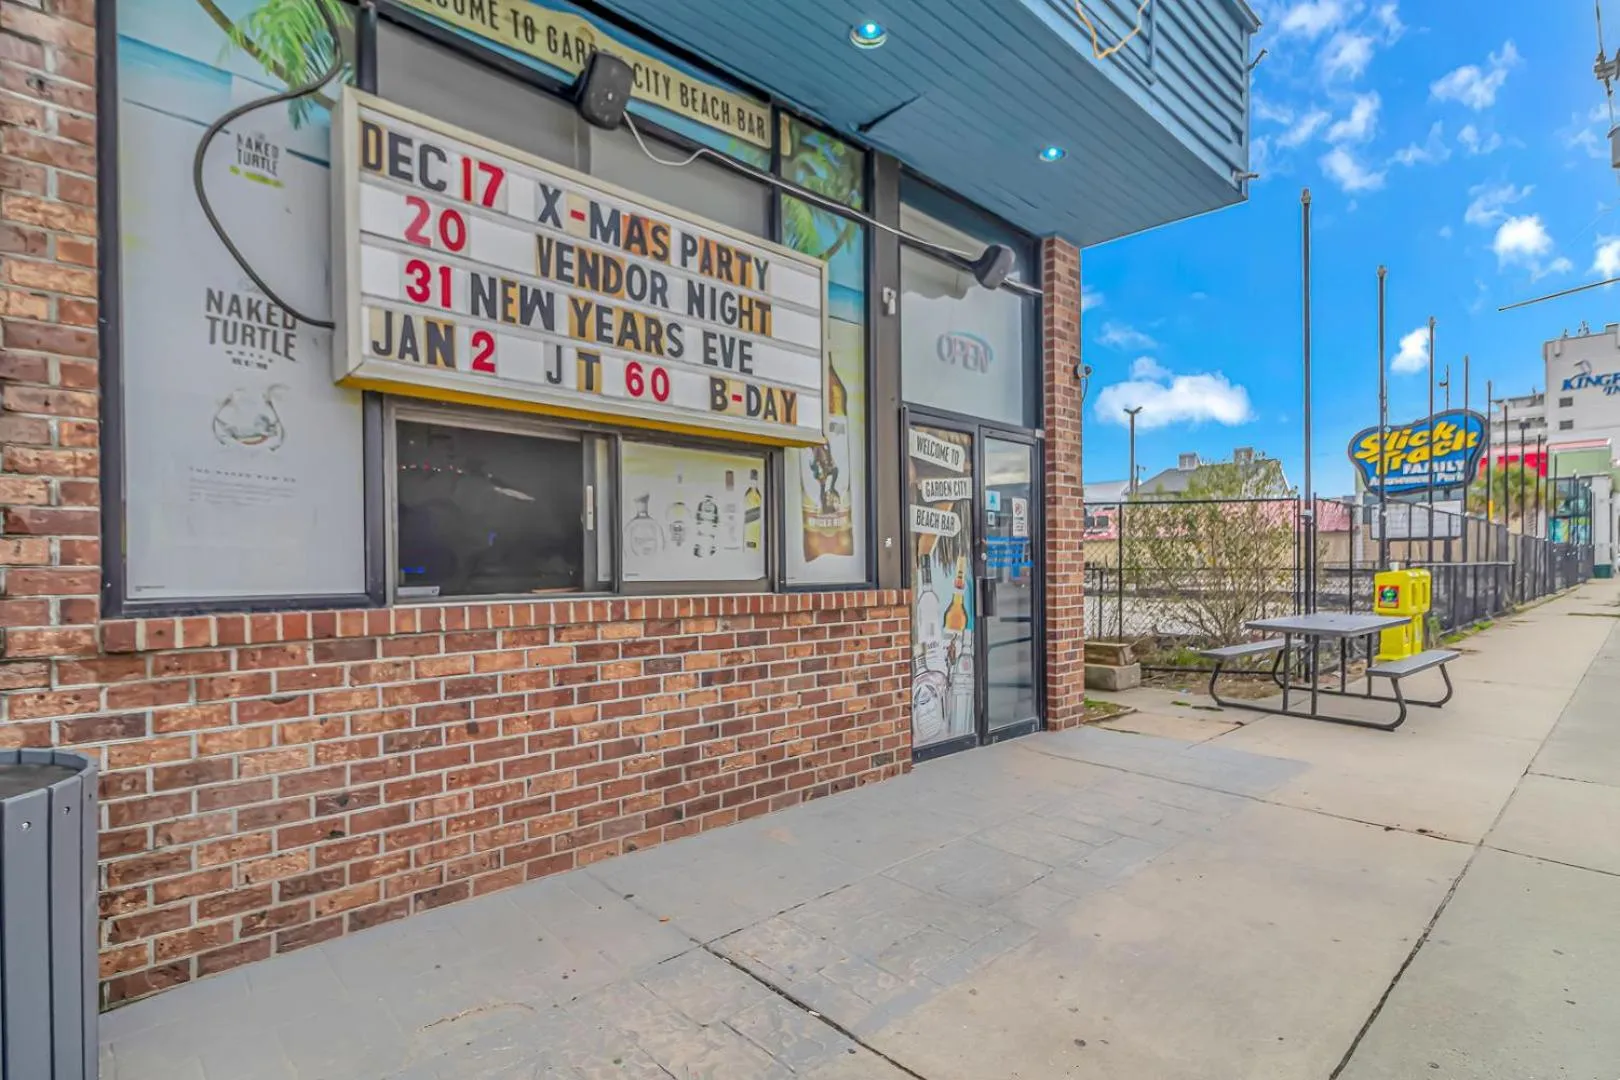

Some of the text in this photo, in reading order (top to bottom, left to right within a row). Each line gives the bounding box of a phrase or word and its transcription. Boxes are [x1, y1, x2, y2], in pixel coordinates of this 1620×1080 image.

[510, 8, 536, 45] TO
[633, 62, 671, 102] CITY
[680, 85, 731, 126] BEACH
[737, 111, 766, 141] BAR
[237, 132, 279, 159] NAKED
[237, 149, 279, 178] TURTLE
[362, 122, 770, 291] DEC 17 X-MAS PARTY
[404, 196, 771, 336] 20 VENDOR NIGHT
[206, 287, 298, 331] NAKED
[406, 259, 753, 374] 31 NEW YEARS EVE
[205, 315, 297, 362] TURTLE
[372, 309, 455, 368] JAN
[471, 330, 496, 373] 2
[624, 361, 670, 402] 60
[710, 378, 796, 425] B-DAY
[916, 435, 960, 466] WELCOME TO
[925, 481, 967, 498] GARDEN CITY
[916, 509, 955, 531] BEACH BAR
